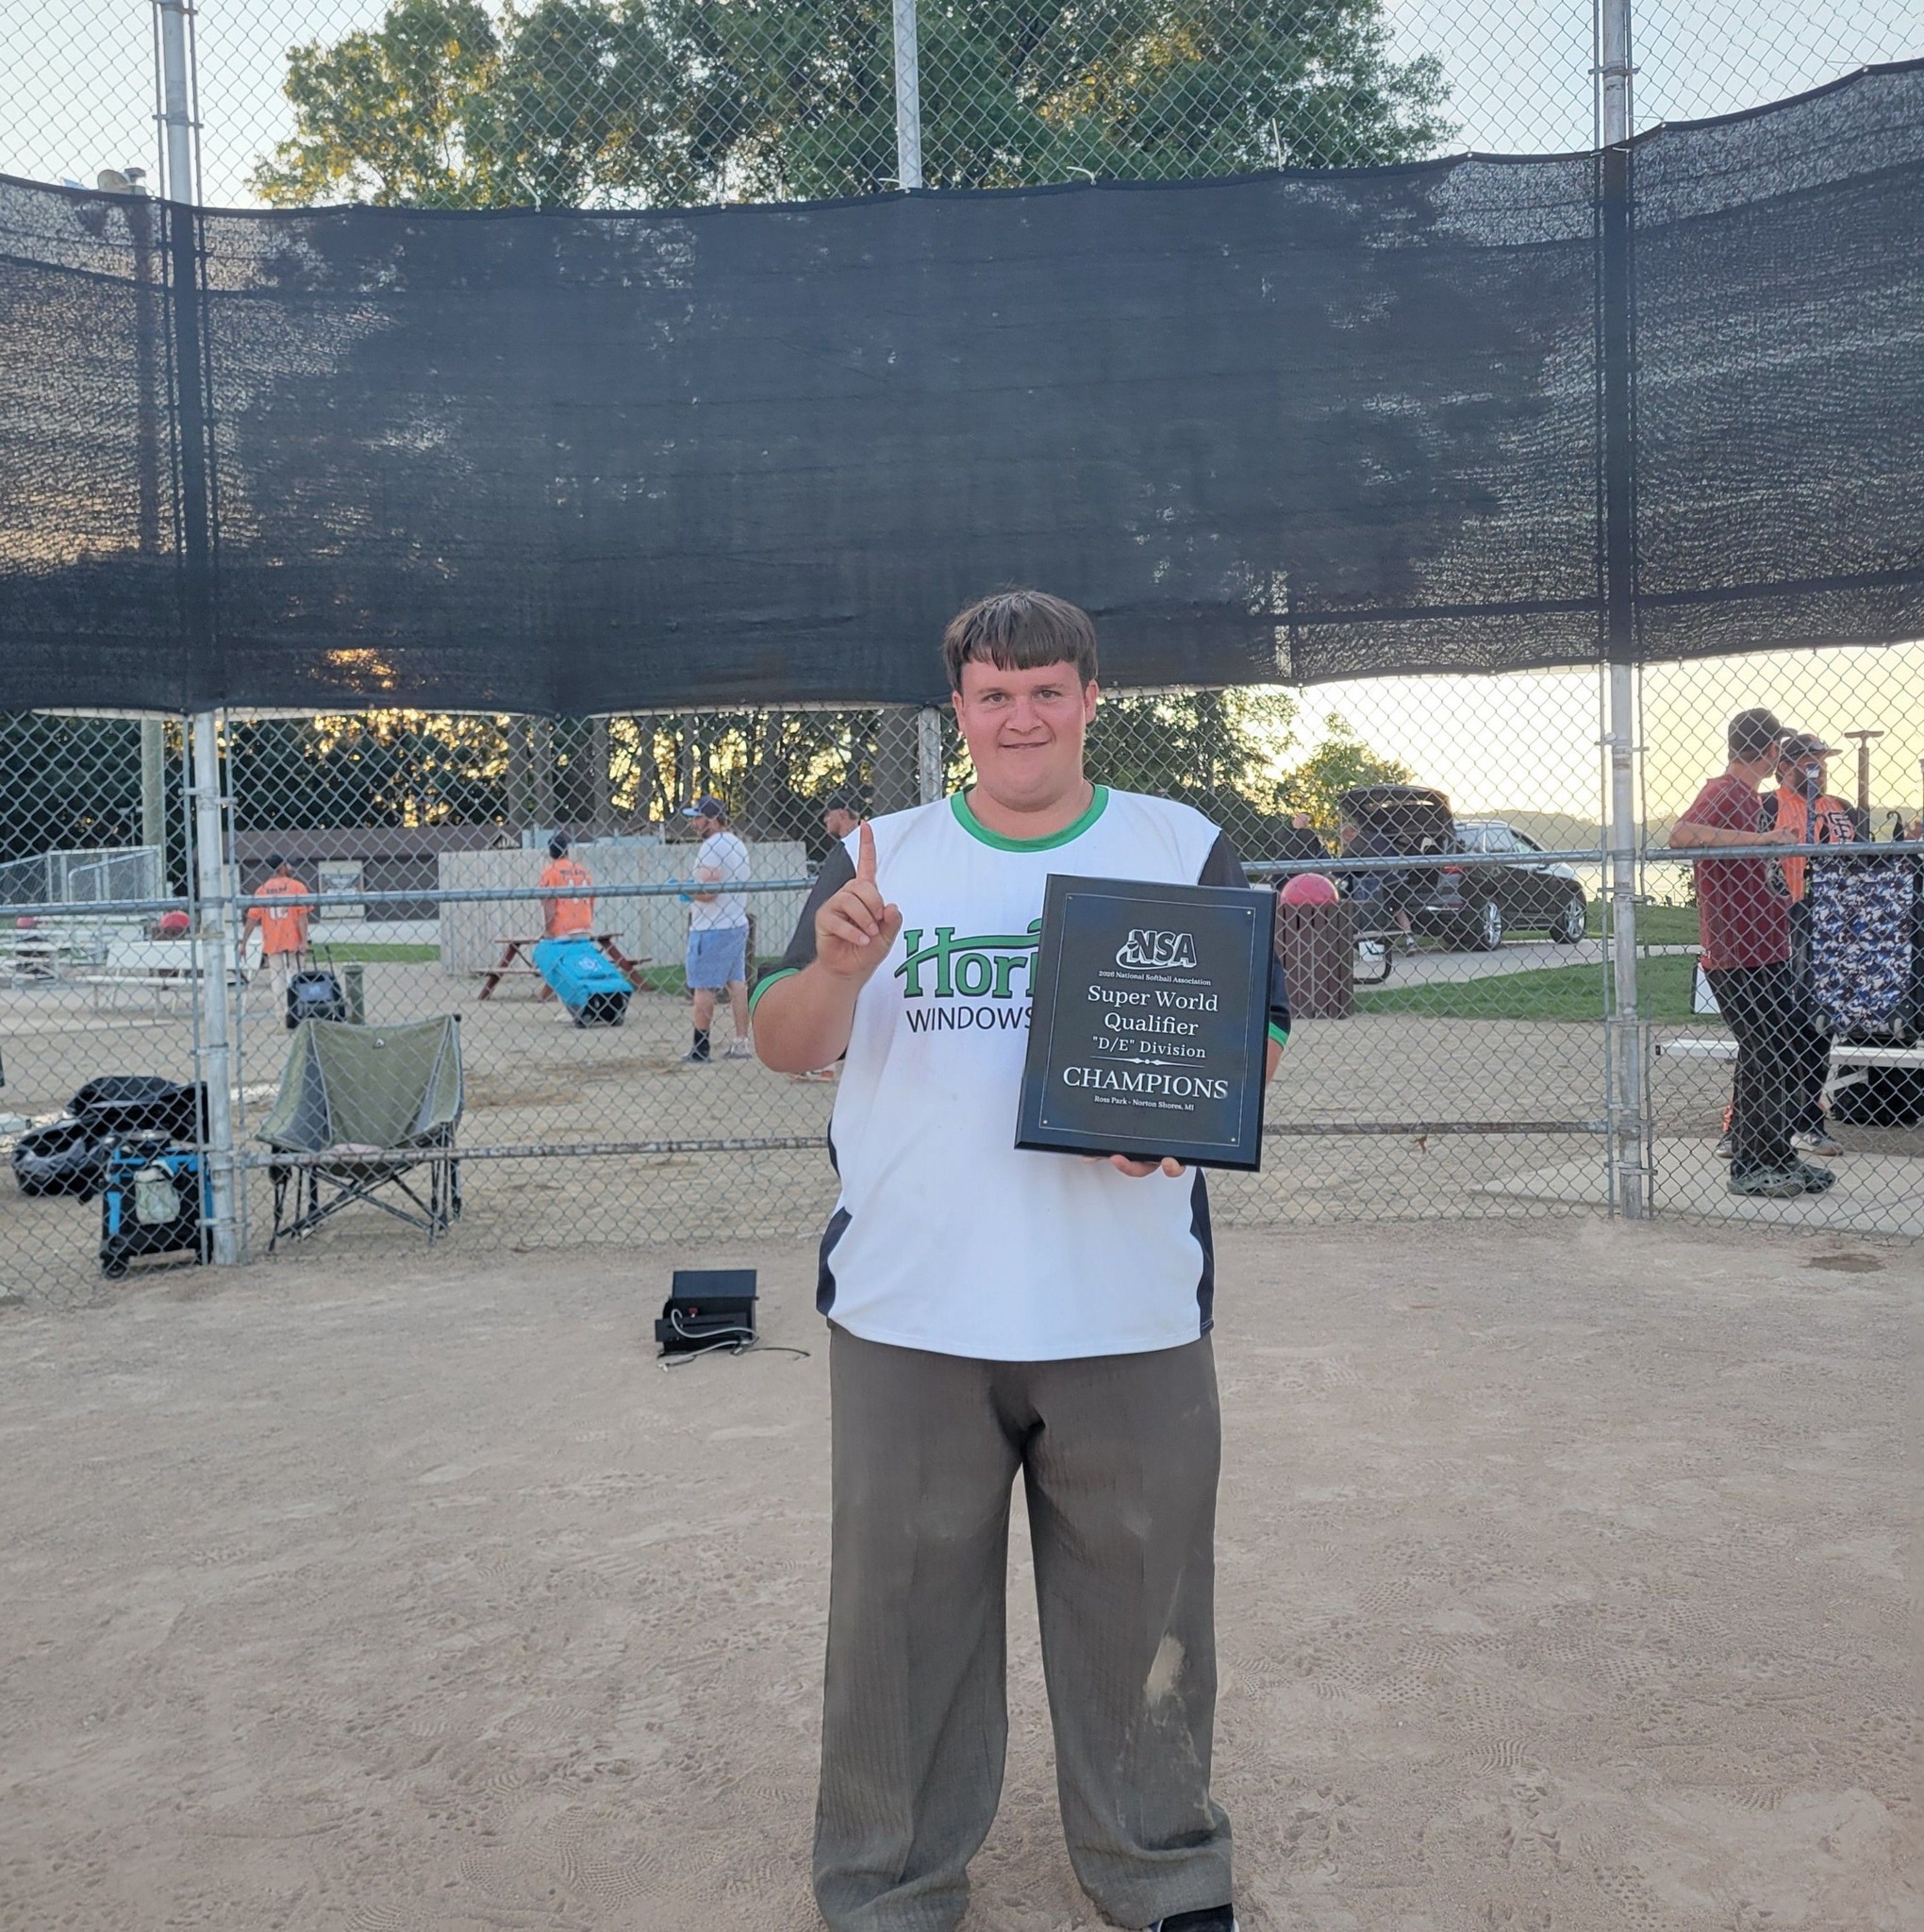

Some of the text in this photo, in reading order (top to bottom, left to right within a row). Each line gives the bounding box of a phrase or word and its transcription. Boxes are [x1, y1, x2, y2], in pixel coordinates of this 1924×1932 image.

[1124, 929, 1197, 968] NSA
[1116, 972, 1145, 980] National
[1146, 974, 1171, 983] Softball
[1172, 976, 1212, 986] Association
[1087, 985, 1219, 1011] Super World
[1104, 1012, 1199, 1036] Qualifier
[1092, 1036, 1206, 1058] "D/E" Division
[1063, 1066, 1229, 1099] CHAMPIONS
[1094, 1095, 1110, 1104] Ross
[1133, 1099, 1157, 1108] Norton
